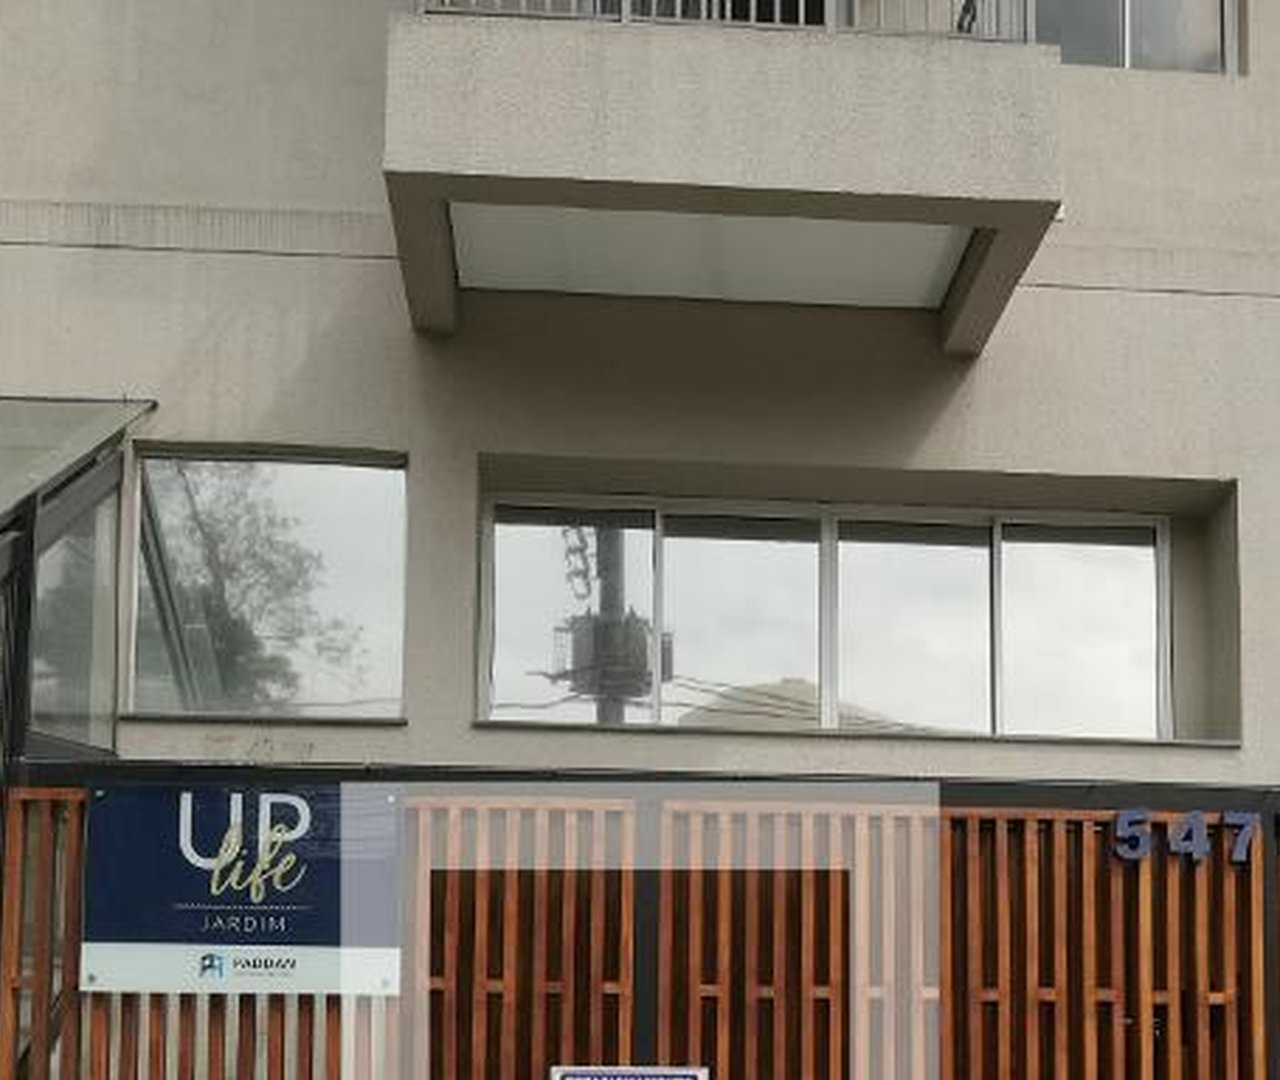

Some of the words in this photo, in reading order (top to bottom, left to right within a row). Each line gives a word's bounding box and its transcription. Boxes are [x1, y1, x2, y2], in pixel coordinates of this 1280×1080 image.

[178, 792, 311, 870] UP
[210, 823, 308, 902] life
[1116, 808, 1261, 861] 547
[202, 916, 287, 932] JARDIM
